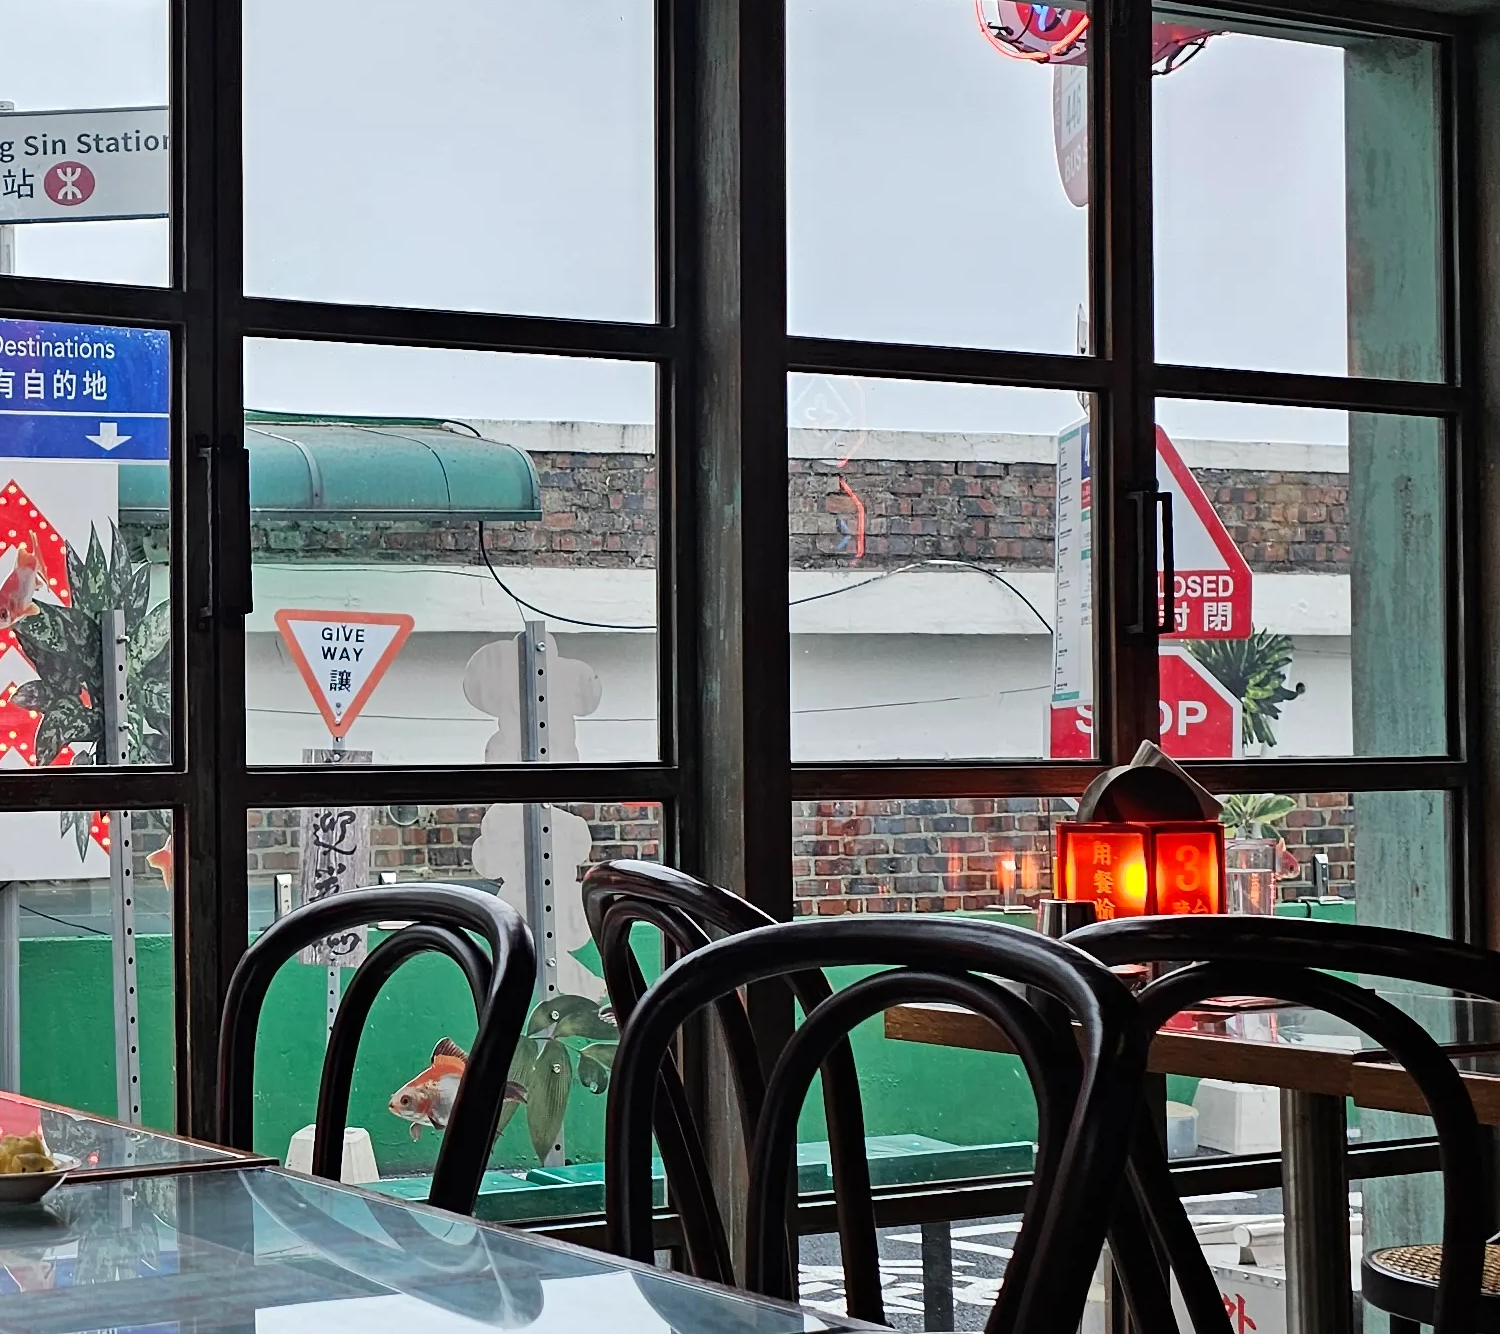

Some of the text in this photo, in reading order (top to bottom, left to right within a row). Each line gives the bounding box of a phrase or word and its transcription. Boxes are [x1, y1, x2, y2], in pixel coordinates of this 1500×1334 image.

[23, 133, 67, 157] Sin
[1064, 144, 1082, 184] BUS
[321, 626, 365, 643] GIVE
[321, 645, 364, 663] WAY
[329, 669, 352, 693] 讓
[1175, 844, 1201, 892] 3
